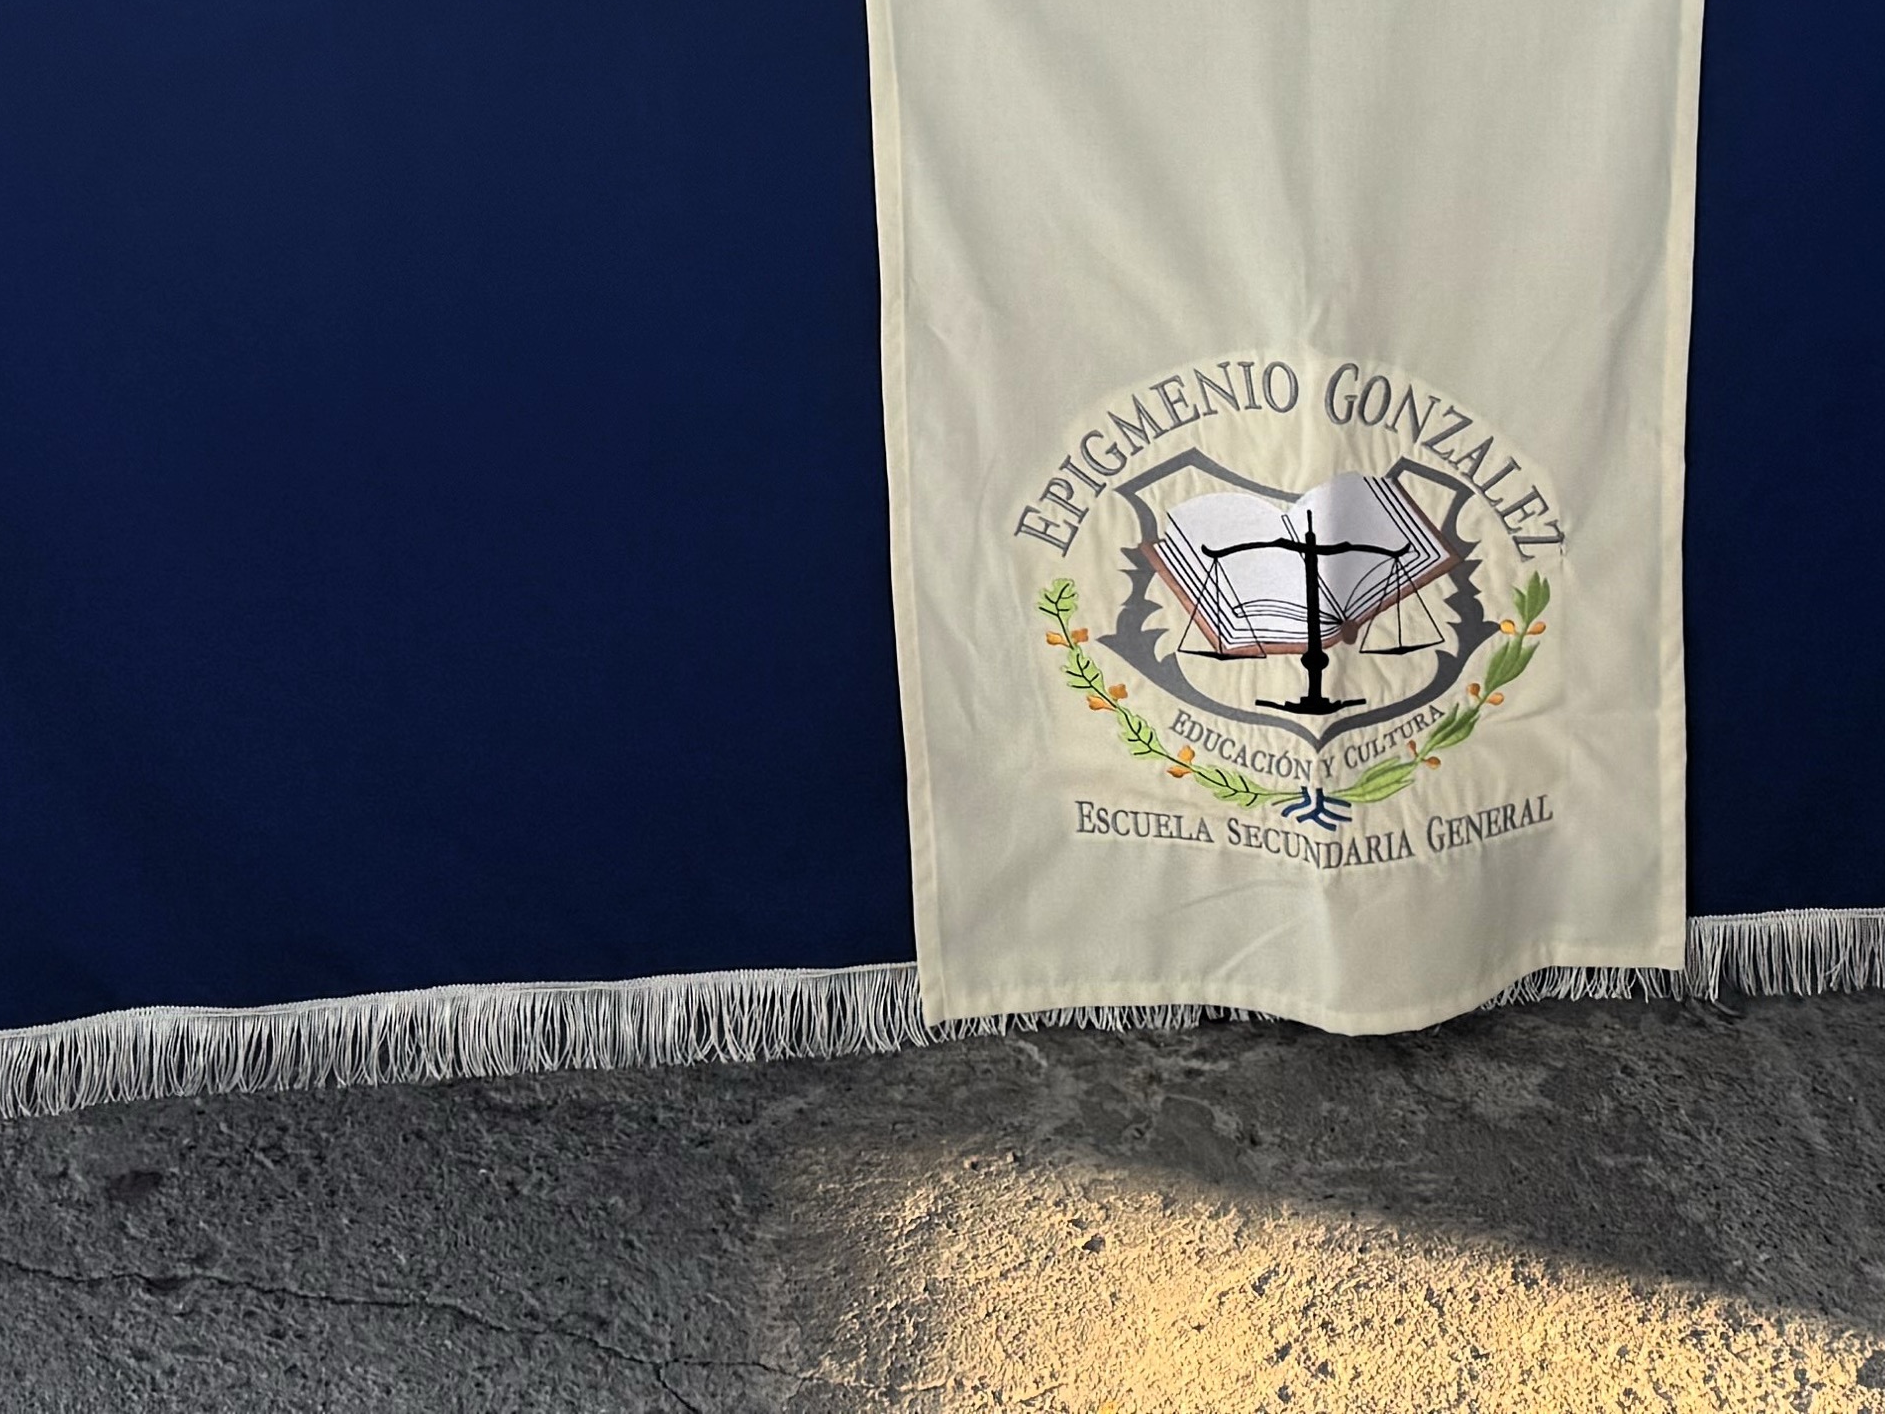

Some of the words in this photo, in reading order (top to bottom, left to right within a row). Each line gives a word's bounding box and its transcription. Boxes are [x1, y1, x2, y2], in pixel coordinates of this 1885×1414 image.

[1014, 361, 1299, 558] EPIGMENIO
[1324, 362, 1566, 563] GONZALEZ
[1168, 708, 1313, 782] EDUCACIÓN
[1319, 755, 1336, 778] Y
[1344, 703, 1446, 770] CULTURA
[1074, 800, 1215, 844] ESCUELA
[1226, 816, 1415, 870] SECUNDARIA
[1425, 794, 1554, 853] GENERAL
